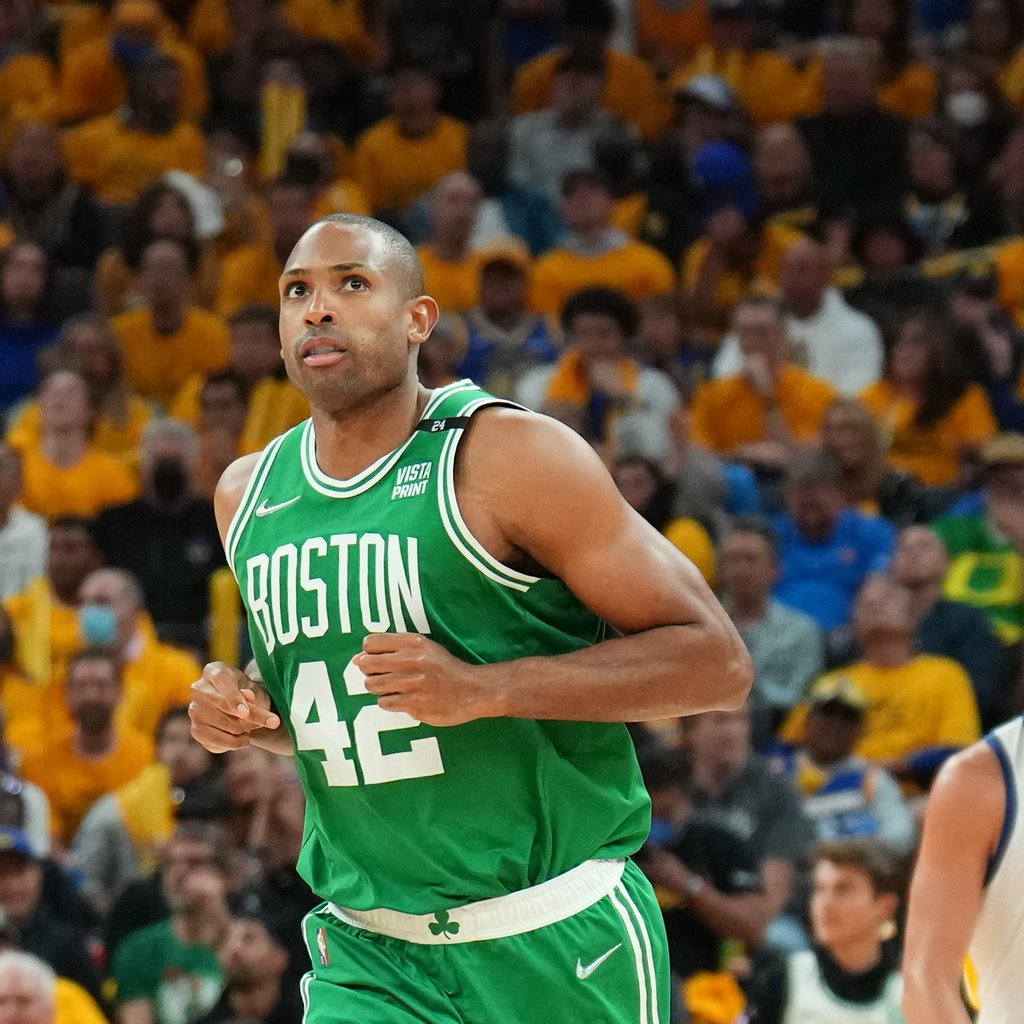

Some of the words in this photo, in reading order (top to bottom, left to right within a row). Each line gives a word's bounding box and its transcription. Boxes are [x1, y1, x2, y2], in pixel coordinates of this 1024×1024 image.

[391, 480, 428, 500] PRINT
[396, 462, 432, 485] VISTA
[246, 532, 431, 656] BOSTON
[290, 651, 445, 787] 42
